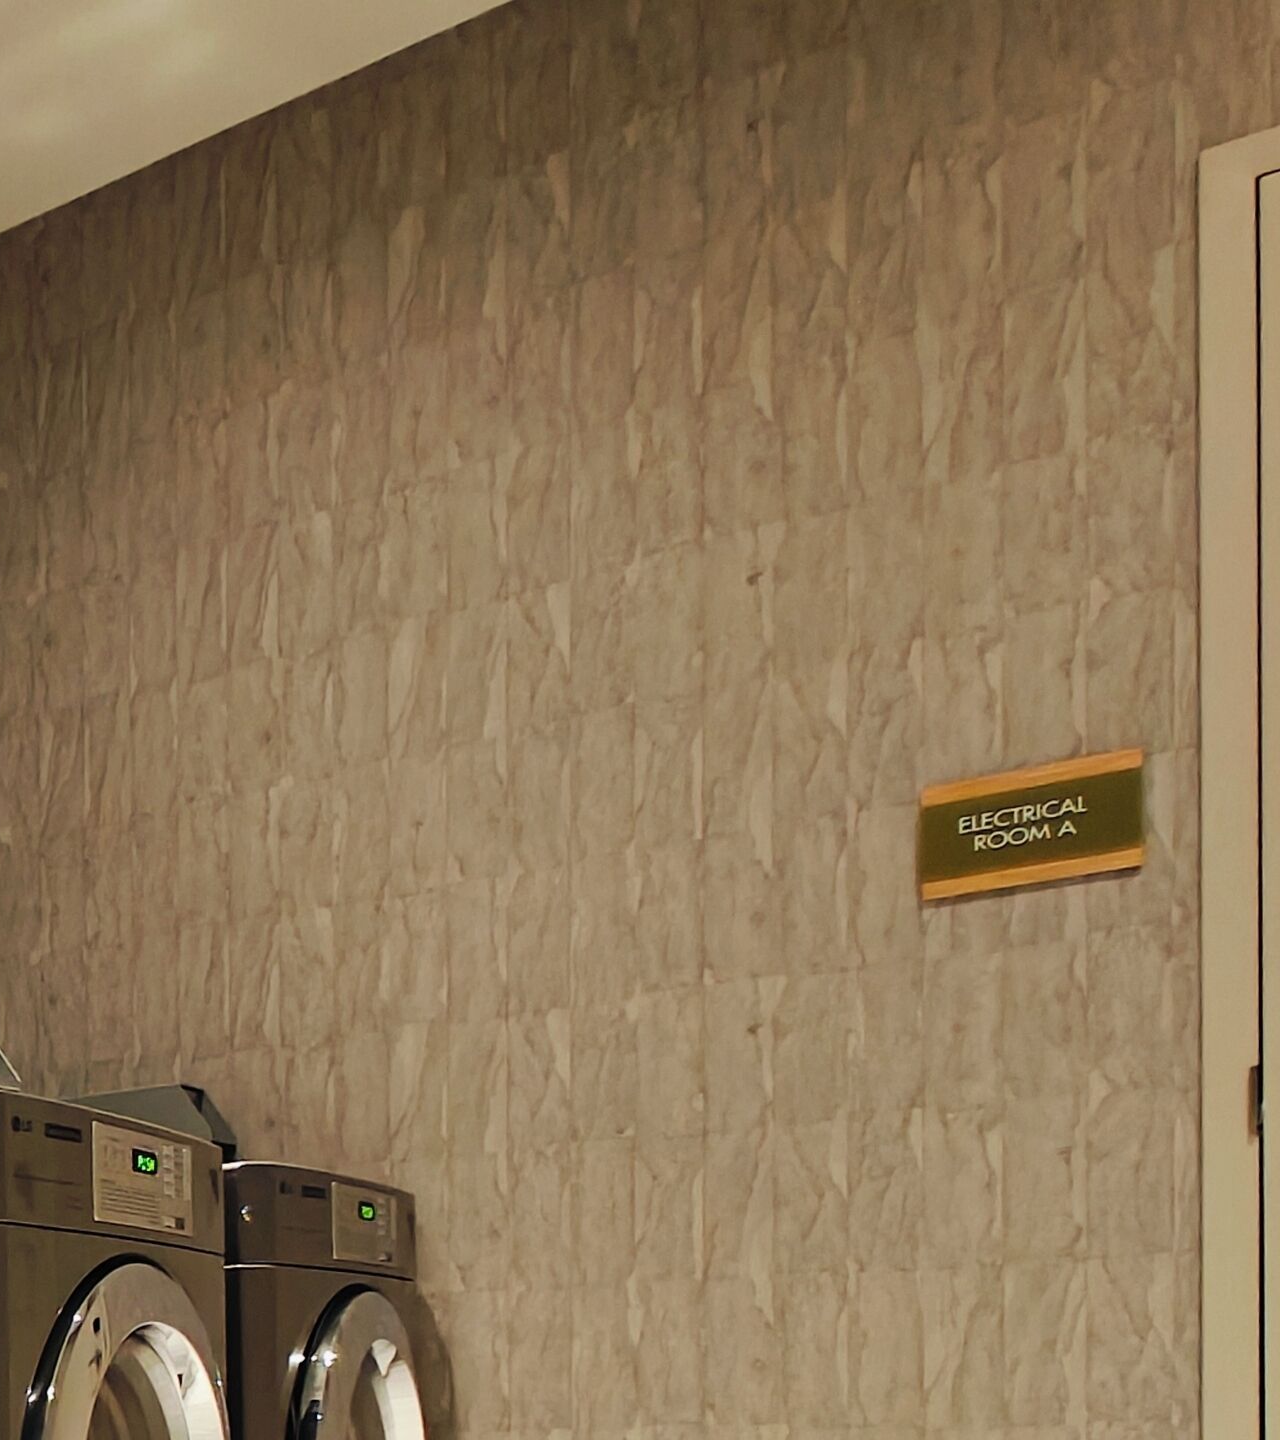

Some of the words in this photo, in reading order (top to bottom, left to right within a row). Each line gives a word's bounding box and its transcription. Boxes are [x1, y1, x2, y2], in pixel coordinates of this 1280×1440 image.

[958, 796, 1088, 834] ELECTRICAL
[974, 824, 1051, 851] ROOM
[1058, 821, 1077, 837] A
